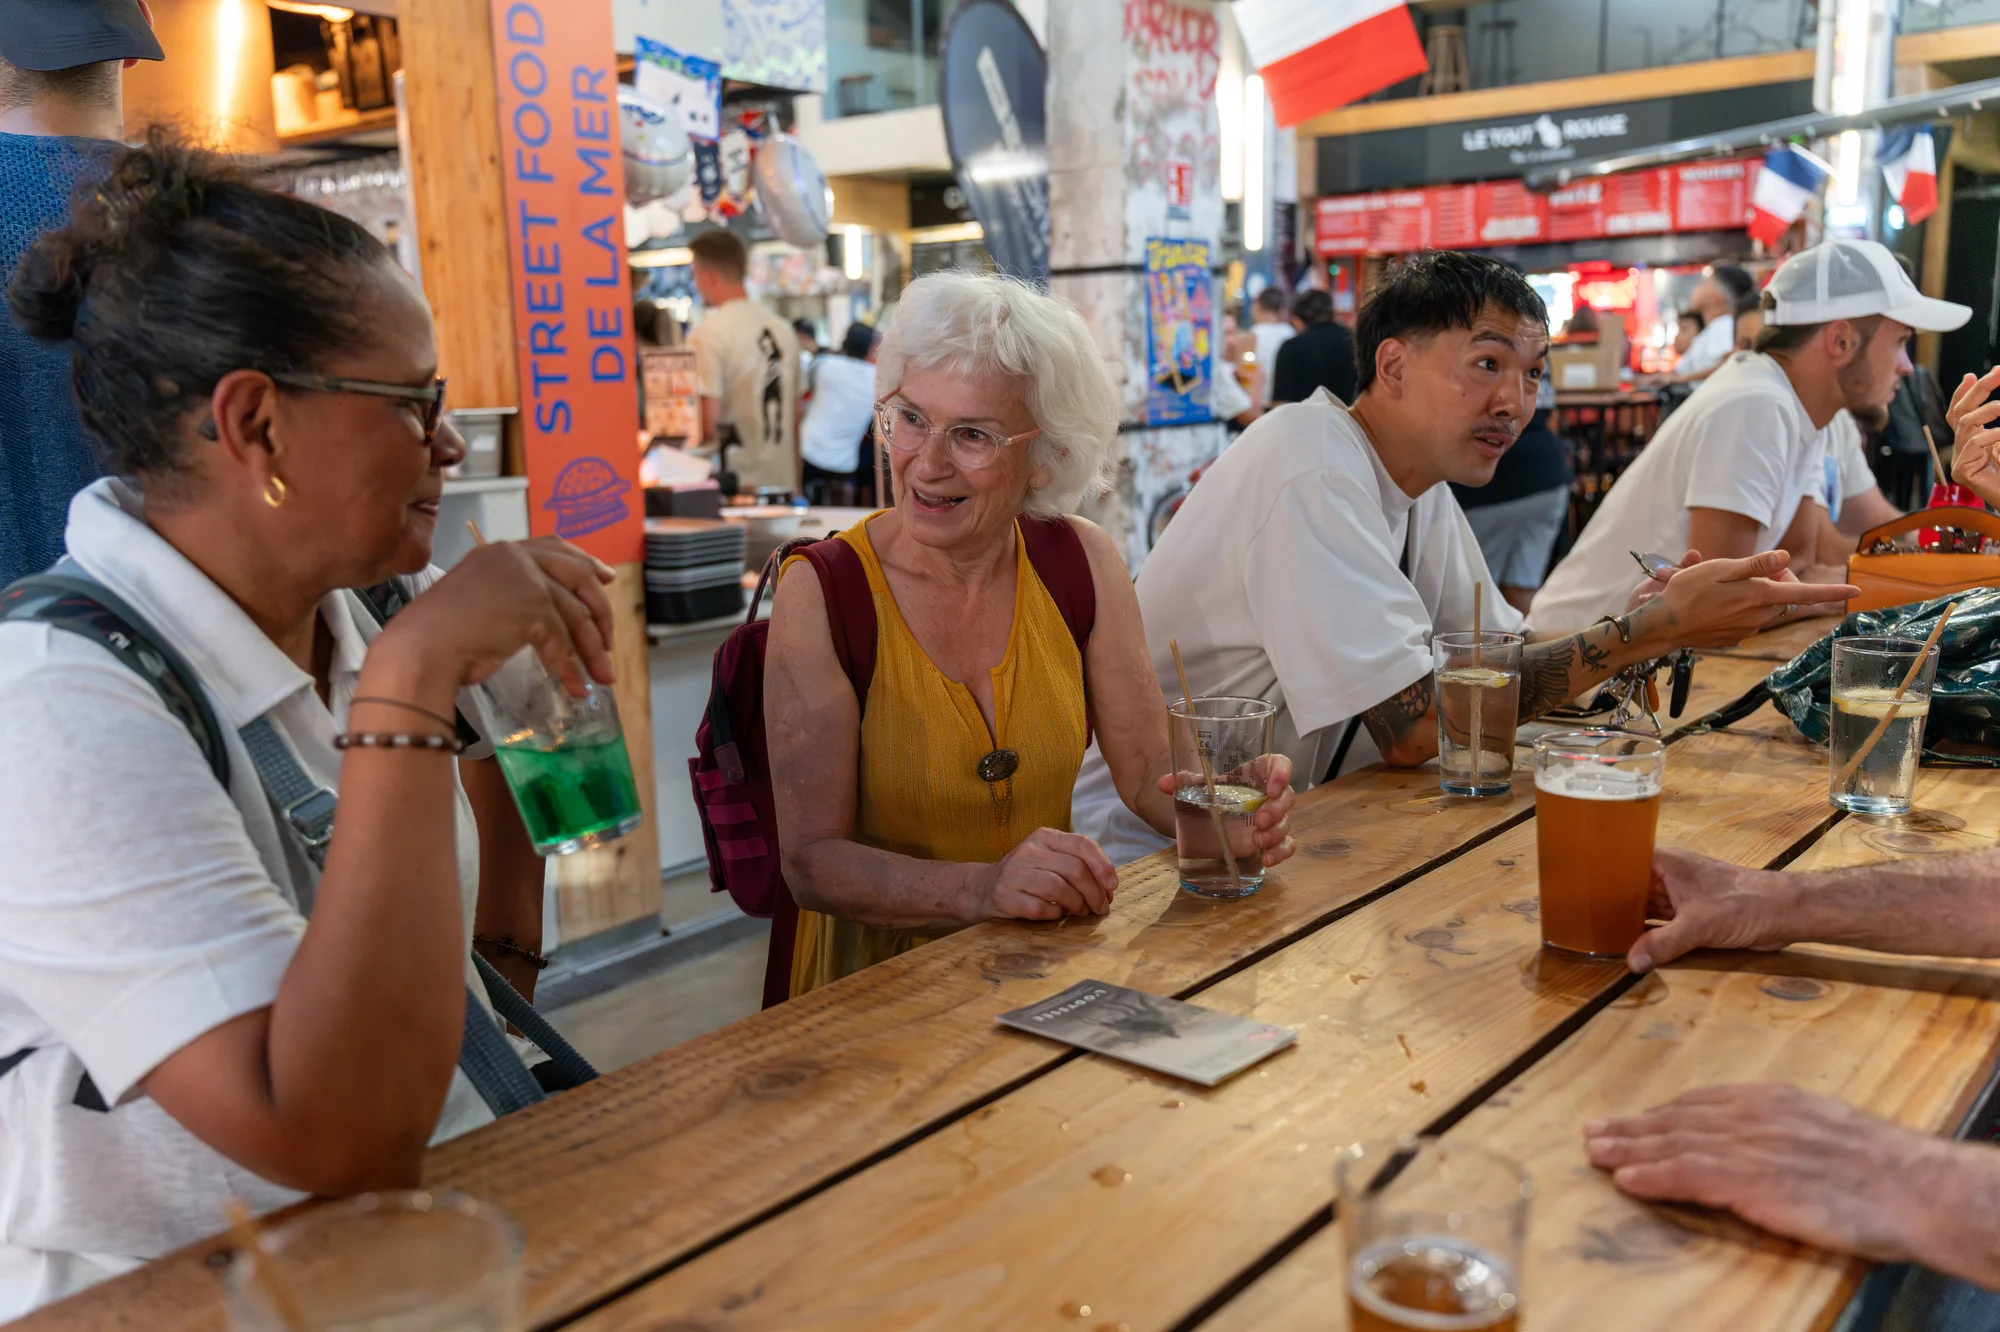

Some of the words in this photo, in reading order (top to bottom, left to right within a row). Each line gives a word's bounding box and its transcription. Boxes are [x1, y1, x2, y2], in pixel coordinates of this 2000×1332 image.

[506, 2, 555, 184] FOOD
[571, 65, 614, 196] MER
[519, 199, 572, 434] STREET
[581, 215, 620, 287] LA
[587, 308, 626, 383] DE
